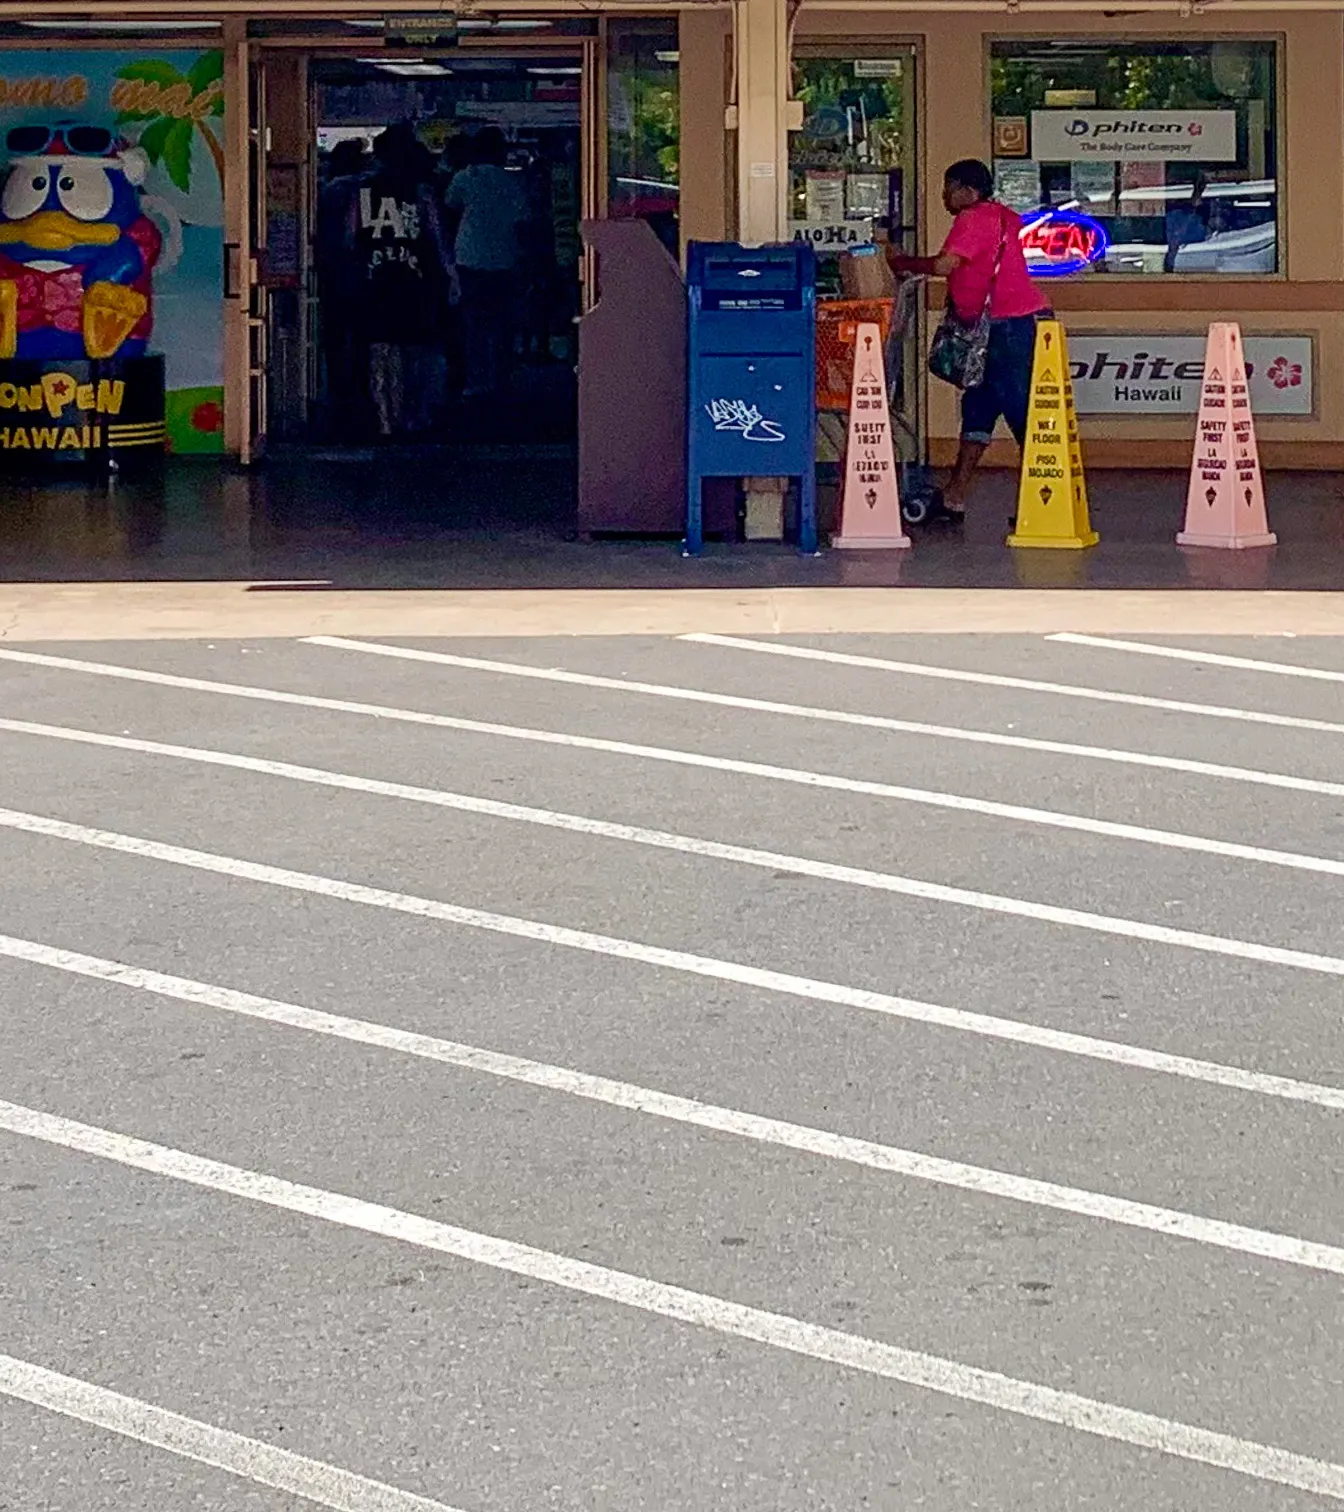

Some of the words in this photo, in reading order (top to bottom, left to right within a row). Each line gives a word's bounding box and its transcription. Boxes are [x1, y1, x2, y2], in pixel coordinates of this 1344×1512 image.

[389, 18, 453, 27] ENTRANCE
[405, 33, 439, 44] ONLY
[1092, 120, 1182, 137] phiten
[1080, 142, 1097, 151] The
[1100, 142, 1122, 153] Body
[1124, 142, 1146, 151] Care
[1148, 142, 1193, 154] Company
[360, 187, 408, 238] LA
[793, 226, 858, 245] ALOHA
[1115, 385, 1181, 402] Hawaii
[1038, 420, 1056, 430] WET
[1200, 421, 1227, 431] SAFETY
[1032, 434, 1061, 444] FLOOR
[1203, 433, 1223, 443] FIRST
[1208, 448, 1217, 457] LA
[1036, 455, 1056, 465] PISO
[1029, 469, 1064, 478] MOJADO
